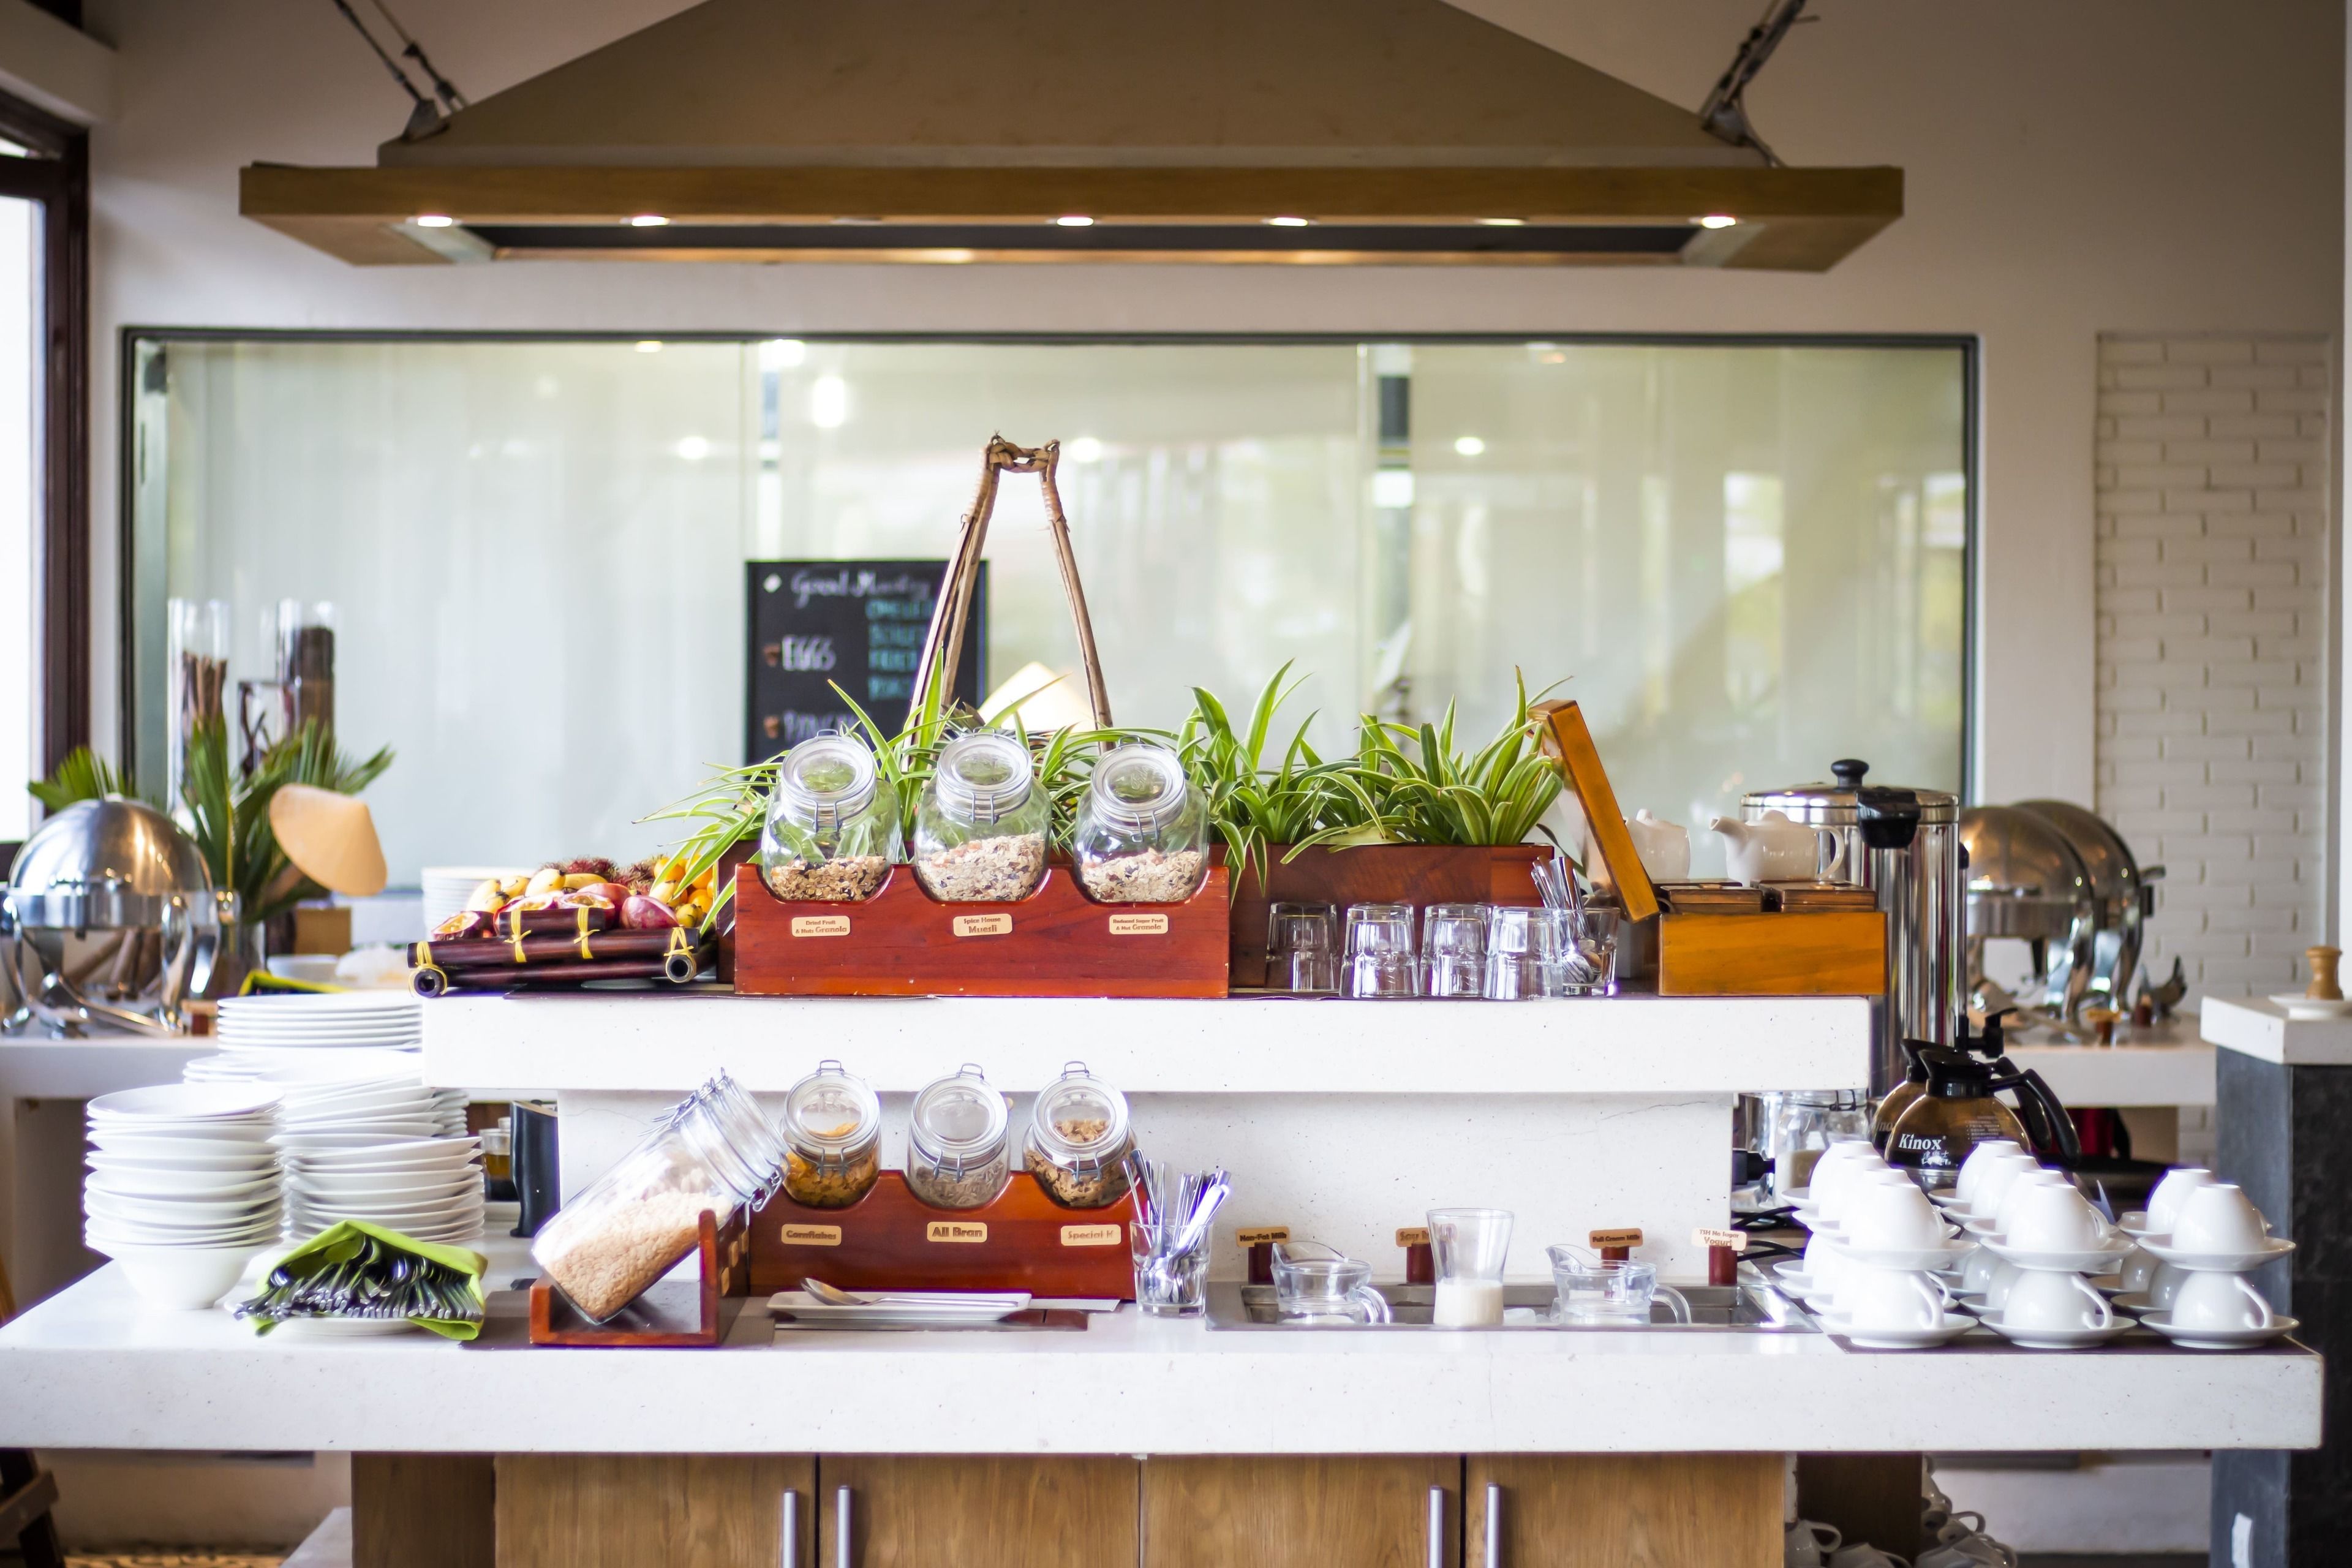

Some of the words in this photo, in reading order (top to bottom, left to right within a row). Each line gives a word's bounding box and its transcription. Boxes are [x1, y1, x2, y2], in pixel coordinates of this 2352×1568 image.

[782, 635, 837, 671] EGGS
[968, 925, 997, 933] Muesli
[1899, 1133, 1942, 1150] Kinox
[786, 1230, 837, 1240] Cornflakes
[932, 1227, 949, 1237] All
[952, 1227, 982, 1237] Bran
[1068, 1231, 1103, 1240] Special
[1400, 1231, 1419, 1243] Soy
[1240, 1233, 1270, 1242] Non-Fat
[1704, 1237, 1732, 1246] Yogurt
